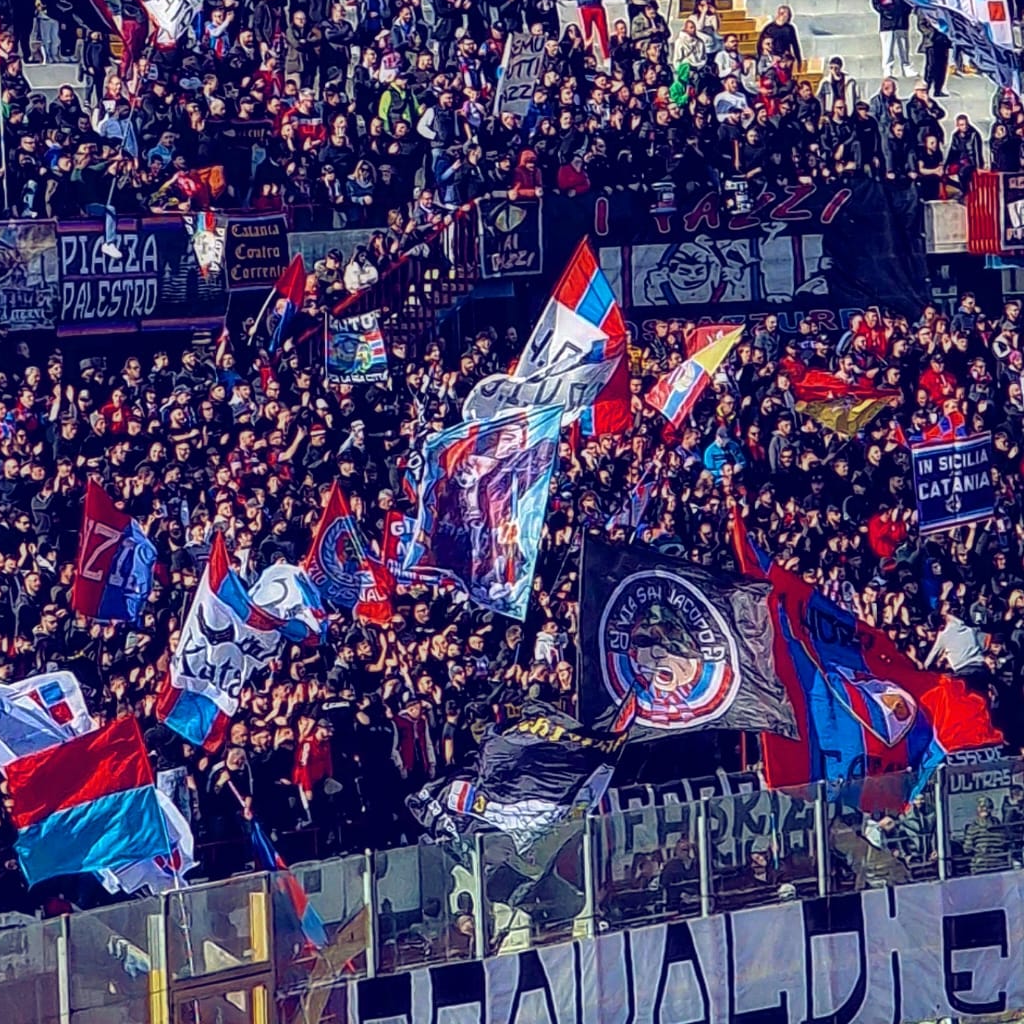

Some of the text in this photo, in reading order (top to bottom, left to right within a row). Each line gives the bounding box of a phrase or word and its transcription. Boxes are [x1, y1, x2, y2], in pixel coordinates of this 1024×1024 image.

[61, 277, 159, 321] PALESTRO
[918, 448, 989, 476] IN SICILIA
[918, 471, 990, 501] CATANIA
